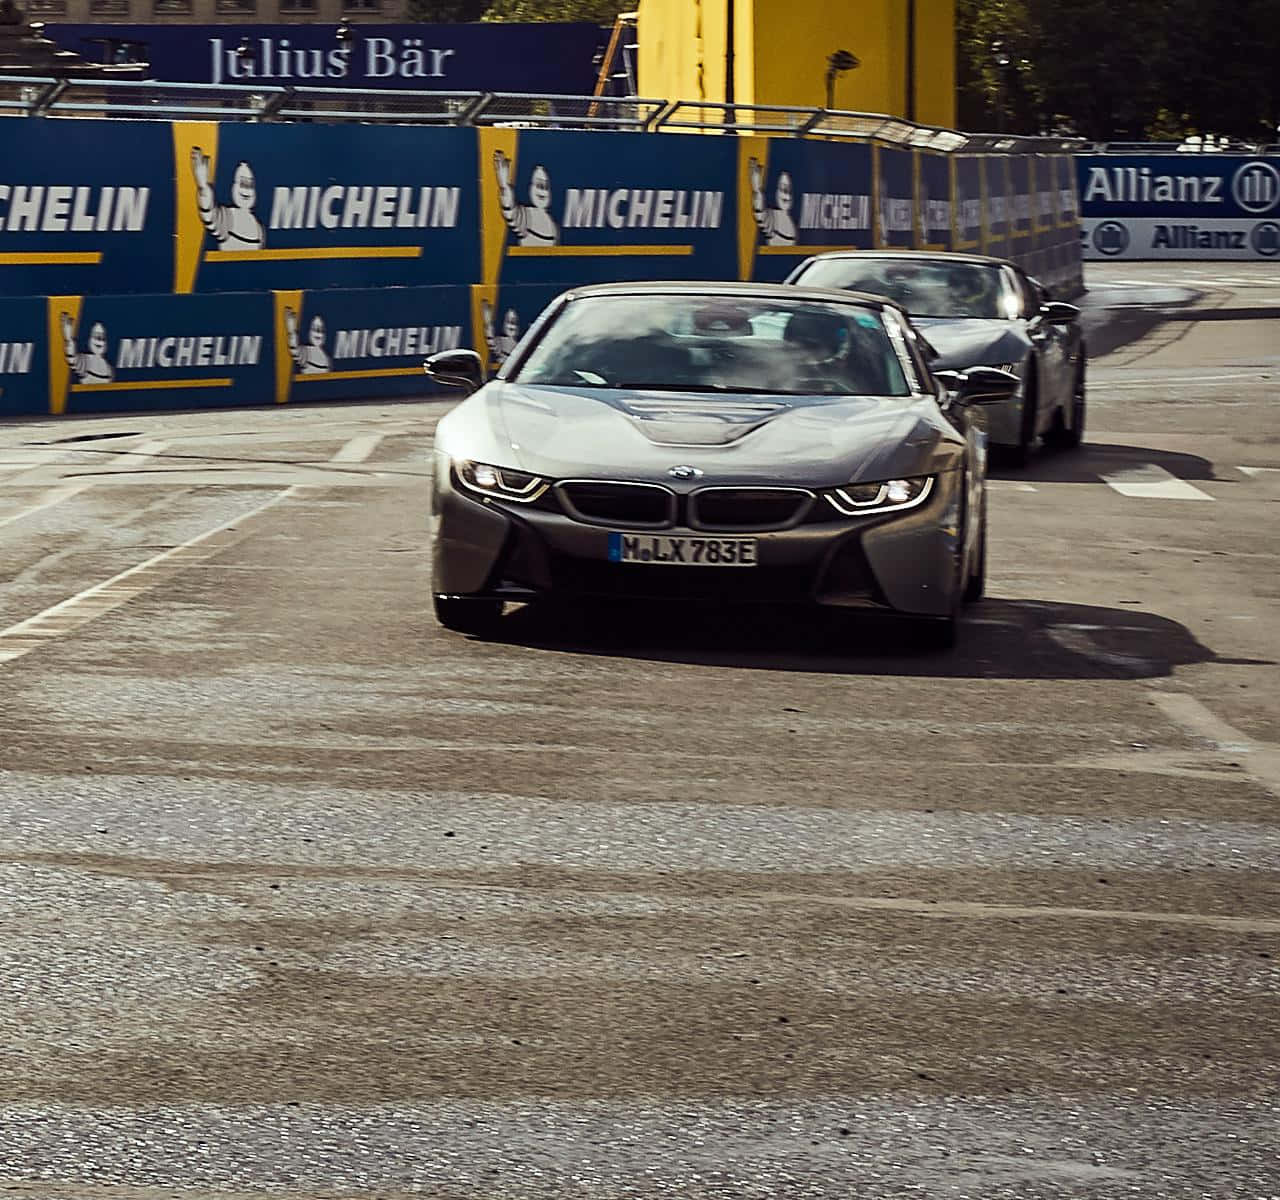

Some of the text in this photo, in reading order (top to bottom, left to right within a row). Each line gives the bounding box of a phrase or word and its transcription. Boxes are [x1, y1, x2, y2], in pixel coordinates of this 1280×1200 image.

[208, 38, 456, 84] Julius Bär
[1084, 167, 1224, 202] Allianz
[269, 186, 461, 231] MICHELIN
[562, 188, 724, 229] MICHELIN
[800, 193, 870, 230] MICHELIN
[1151, 225, 1247, 250] Allianz
[116, 335, 263, 370] MICHELIN
[333, 326, 463, 359] MICHELIN
[690, 540, 756, 564] 783E
